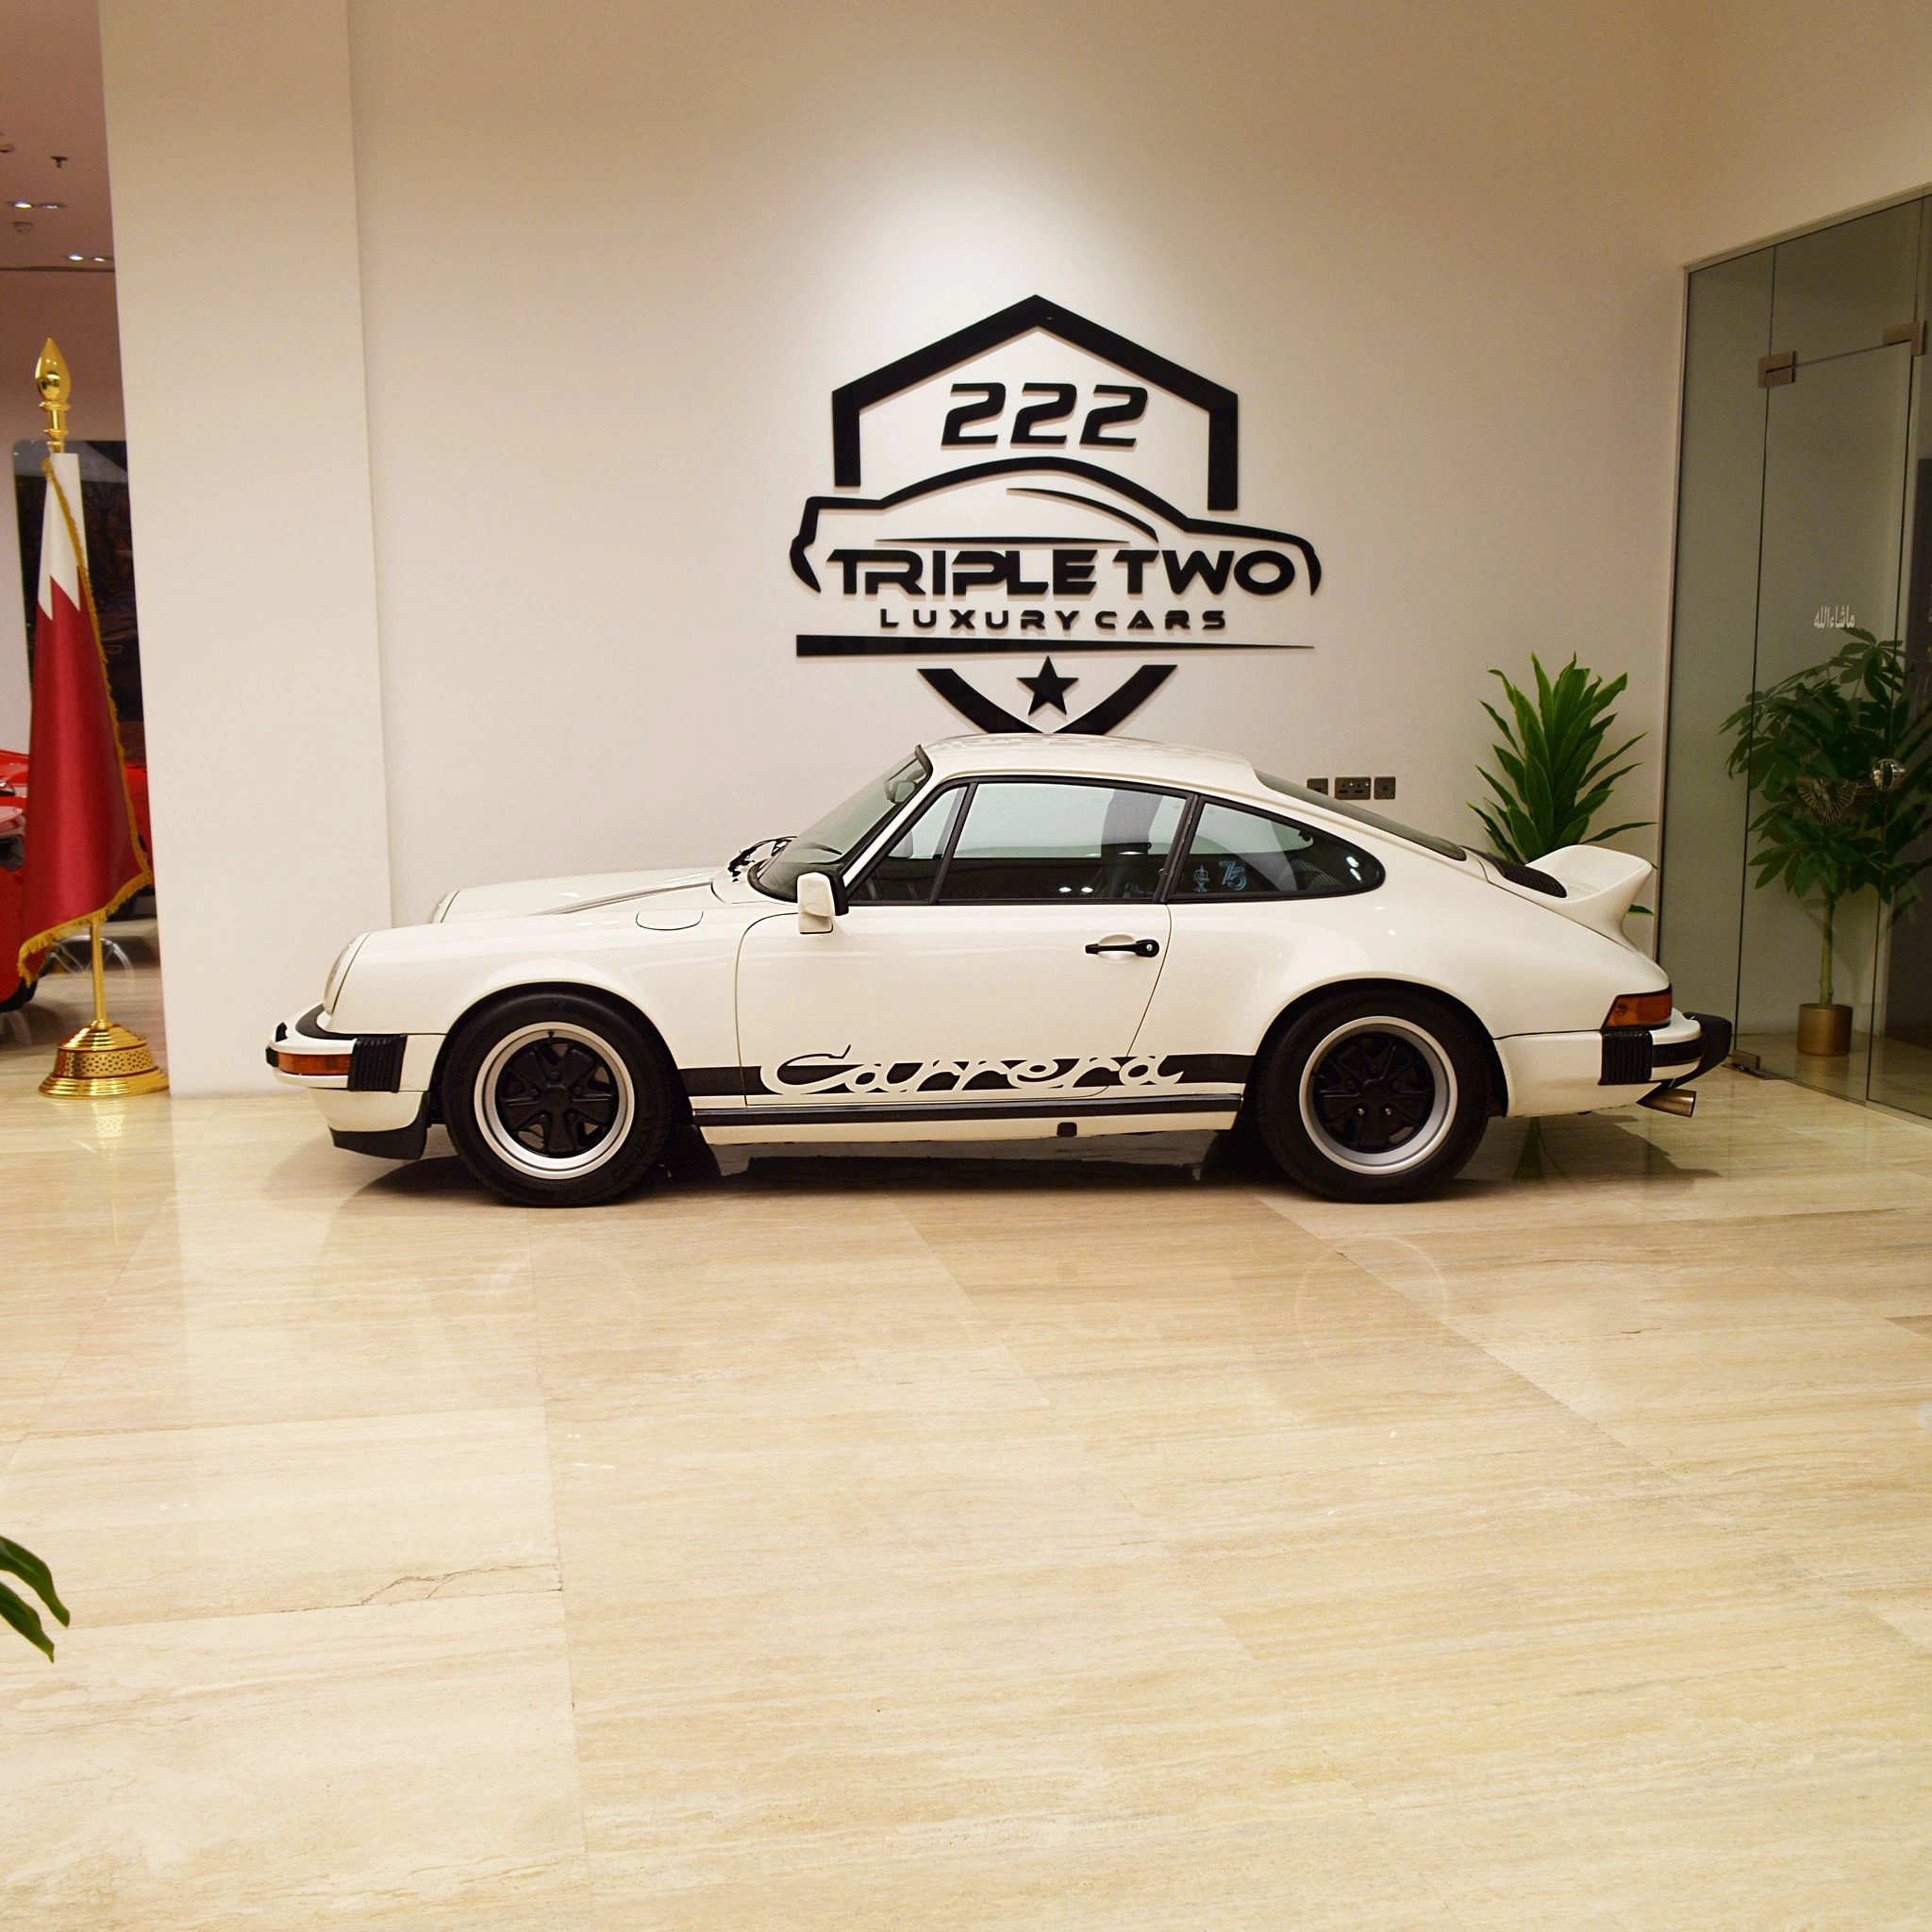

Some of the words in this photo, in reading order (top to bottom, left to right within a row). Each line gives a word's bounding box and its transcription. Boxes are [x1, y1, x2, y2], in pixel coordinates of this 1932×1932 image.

[942, 383, 1148, 446] 222
[826, 549, 1098, 596] TRIPLE
[1112, 549, 1296, 596] TWO
[880, 608, 1079, 630] LUXURY
[1094, 609, 1225, 630] CARS
[760, 1044, 1183, 1096] Carrera
